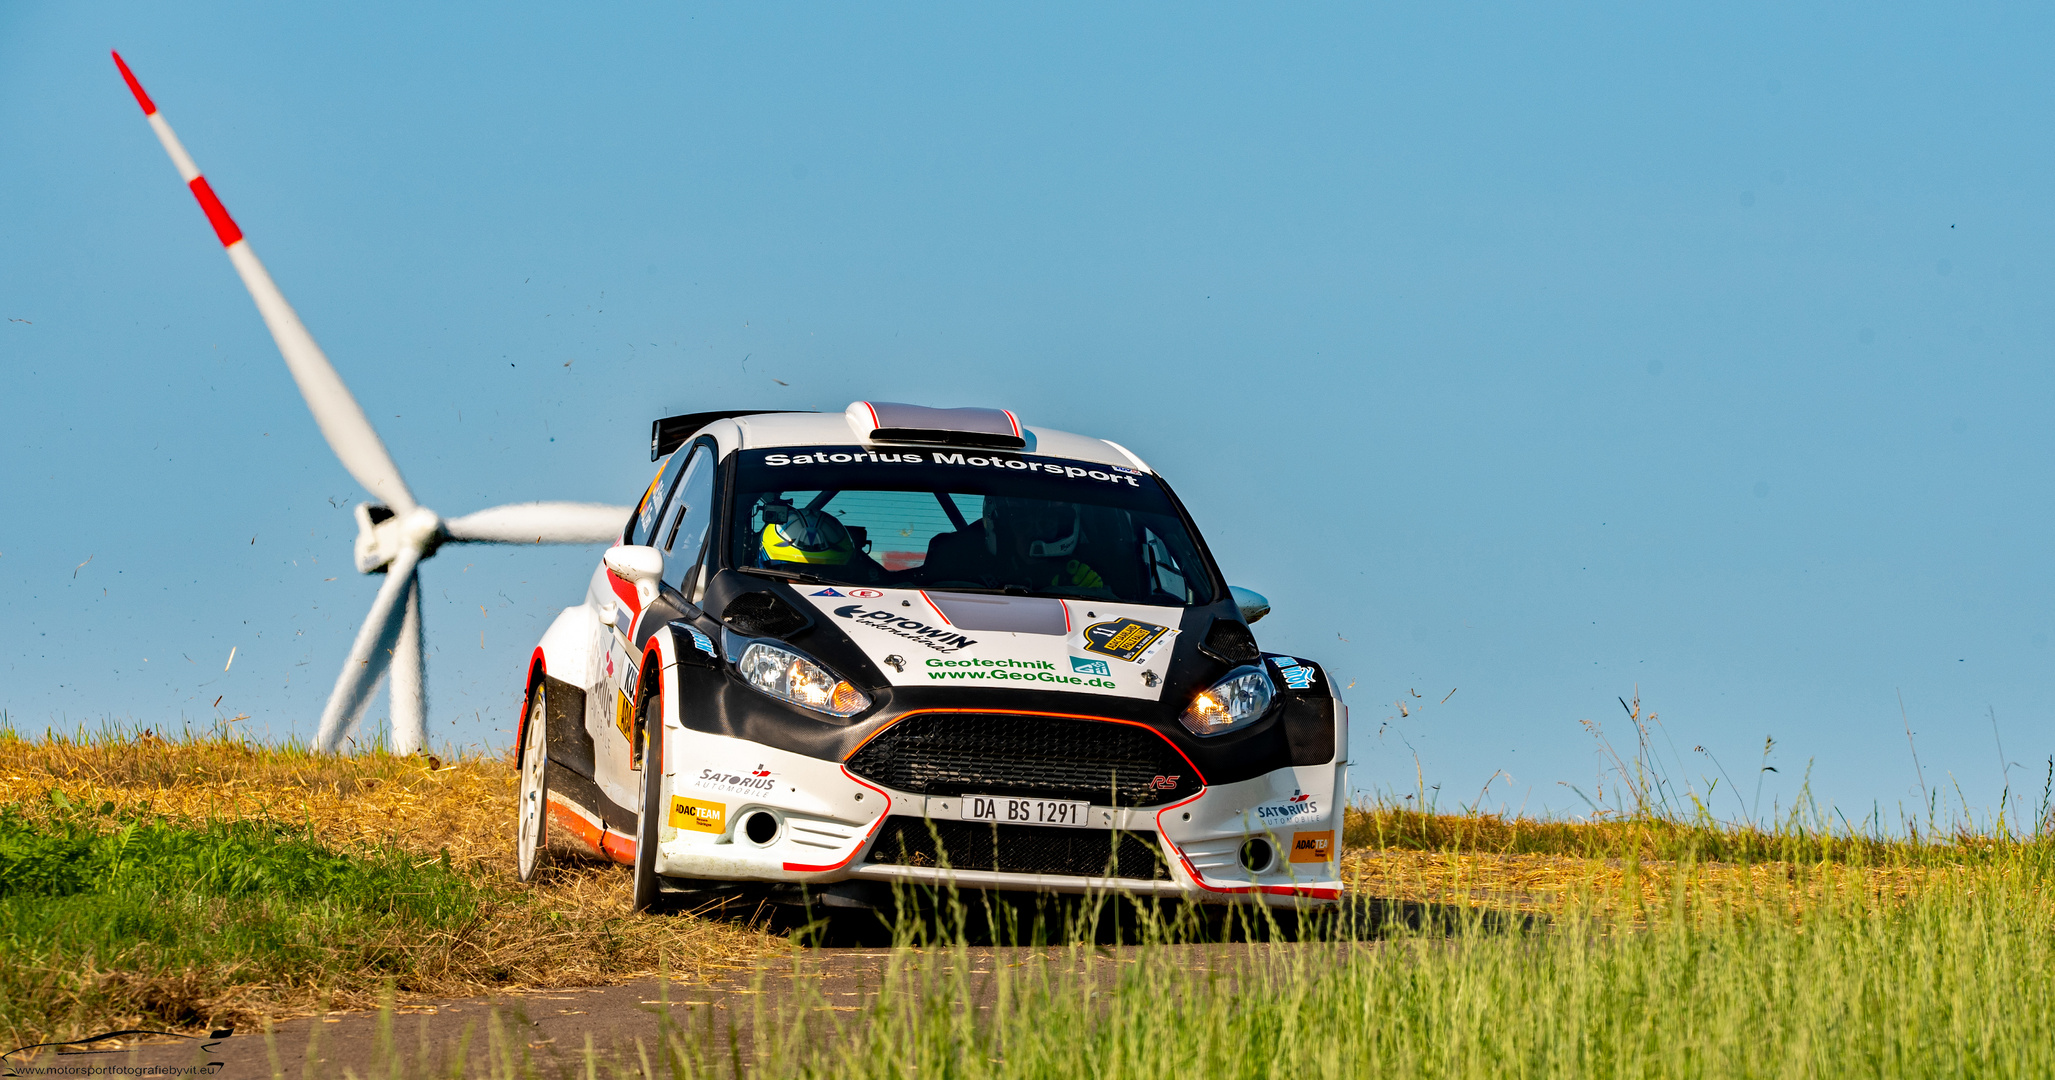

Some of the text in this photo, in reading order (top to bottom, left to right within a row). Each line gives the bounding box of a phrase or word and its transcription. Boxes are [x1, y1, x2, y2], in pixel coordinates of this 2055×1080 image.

[764, 451, 1140, 487] Satorius Motorsport
[855, 618, 959, 654] international
[925, 658, 1056, 671] Geotechnik
[927, 669, 1116, 689] www.GeoGue.de
[700, 768, 776, 790] SATORIUS
[1151, 775, 1180, 789] RS
[695, 781, 770, 798] AUTOMOBILE
[974, 798, 1077, 824] DA BS 1291
[1258, 801, 1318, 818] SATORIUS
[1261, 815, 1320, 826] AUTOMOBILE
